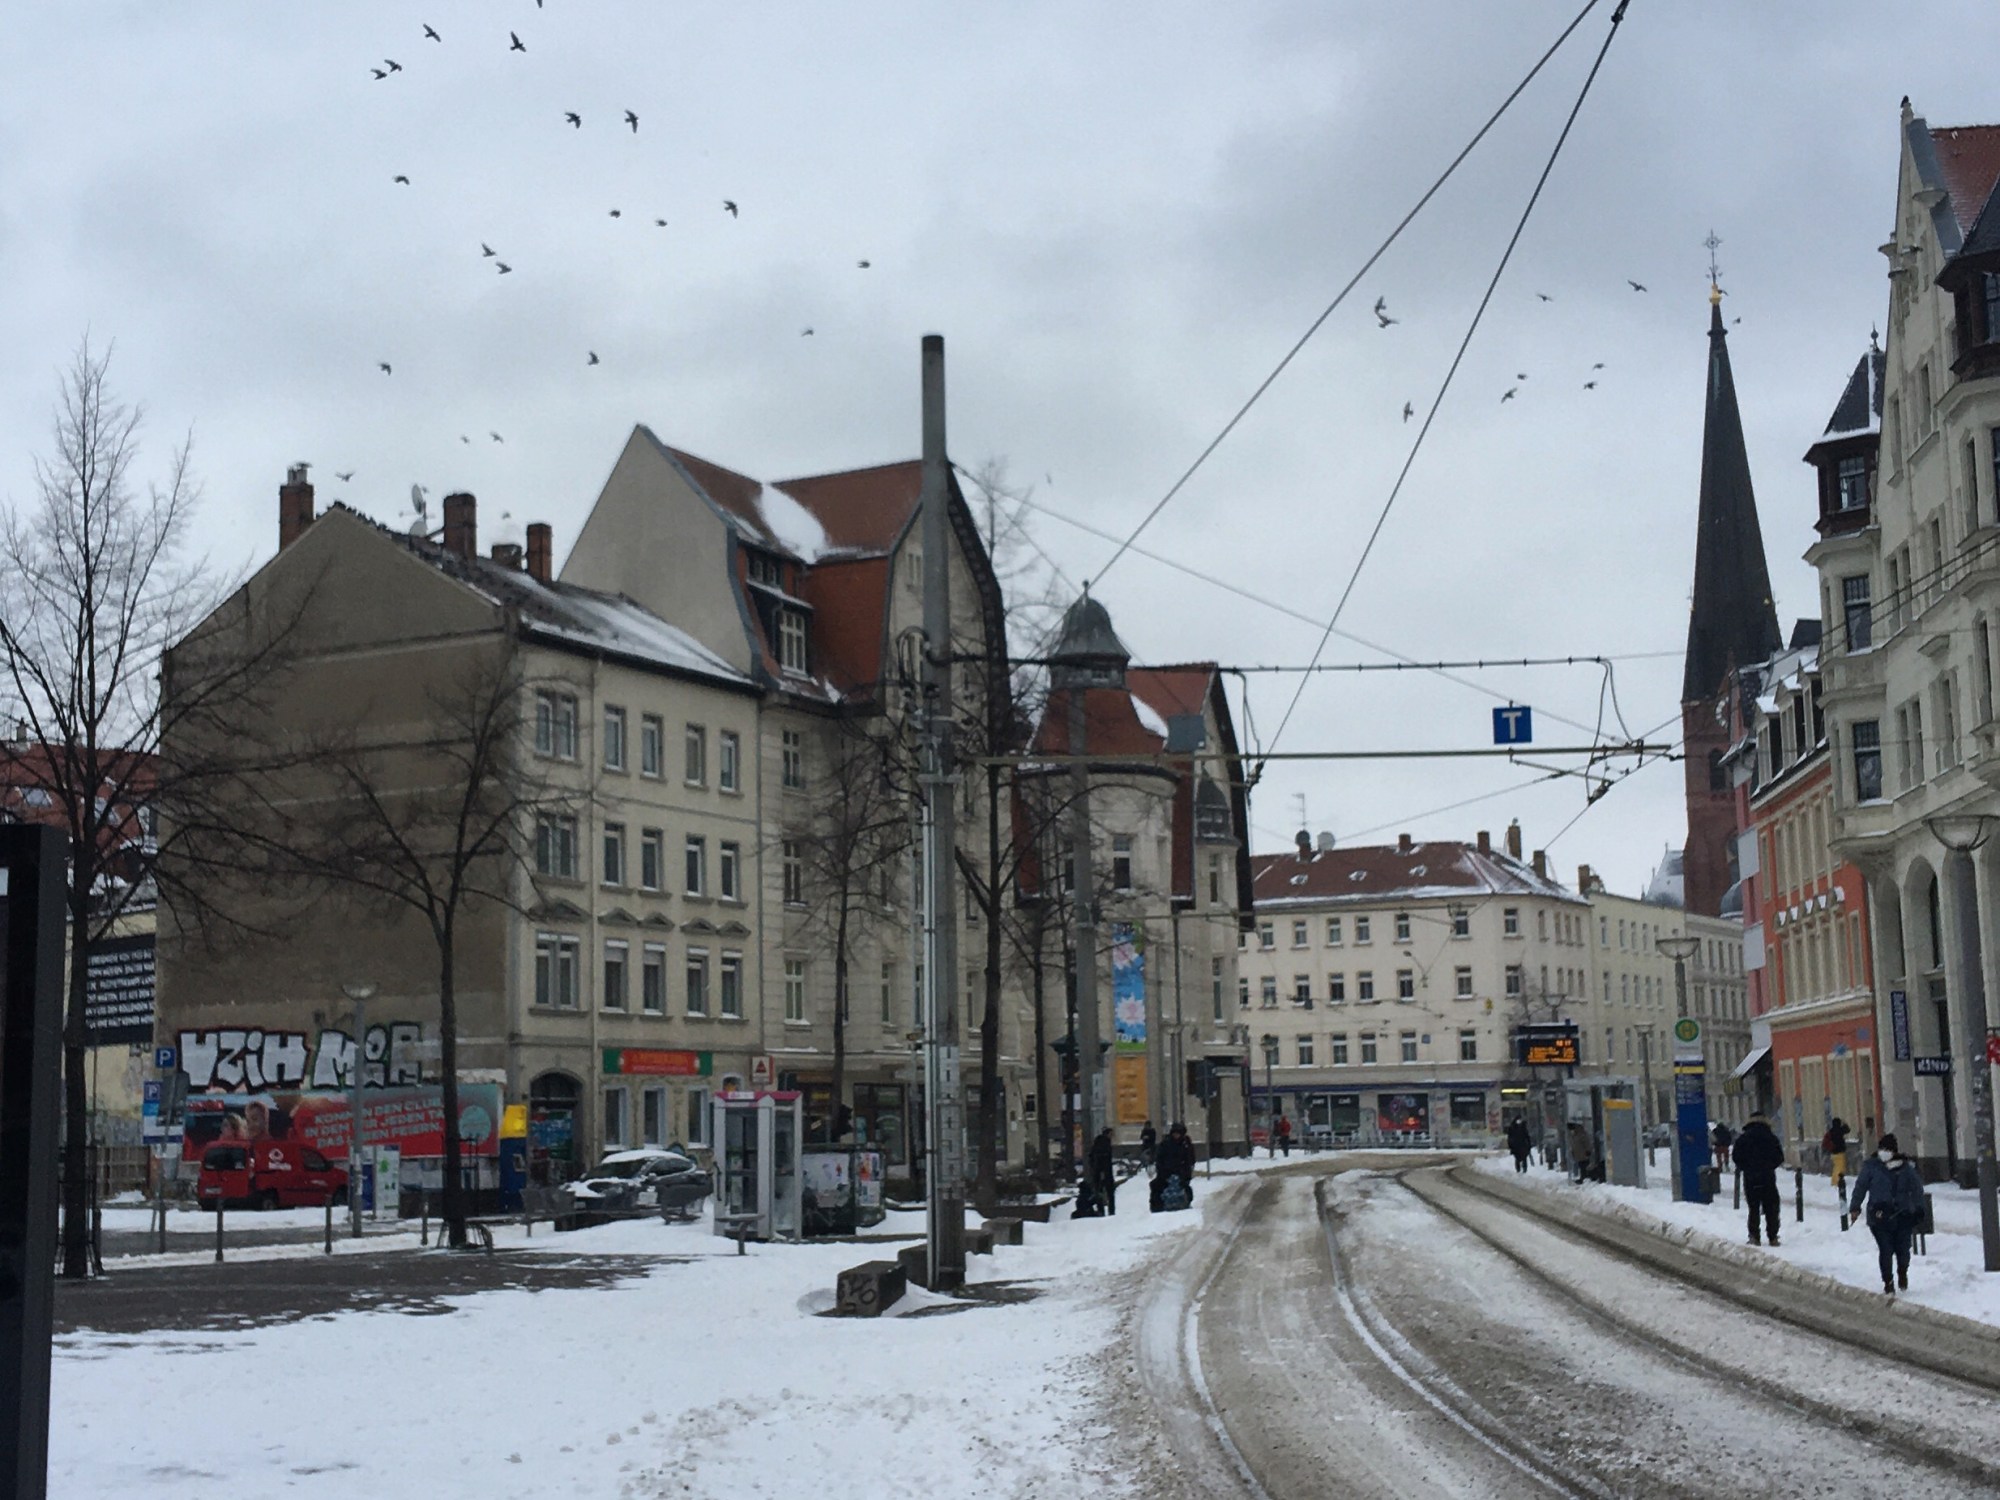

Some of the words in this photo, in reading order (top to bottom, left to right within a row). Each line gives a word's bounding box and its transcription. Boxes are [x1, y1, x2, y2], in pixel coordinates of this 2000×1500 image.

[1502, 711, 1522, 739] T
[160, 1049, 171, 1066] P
[148, 1084, 158, 1097] P
